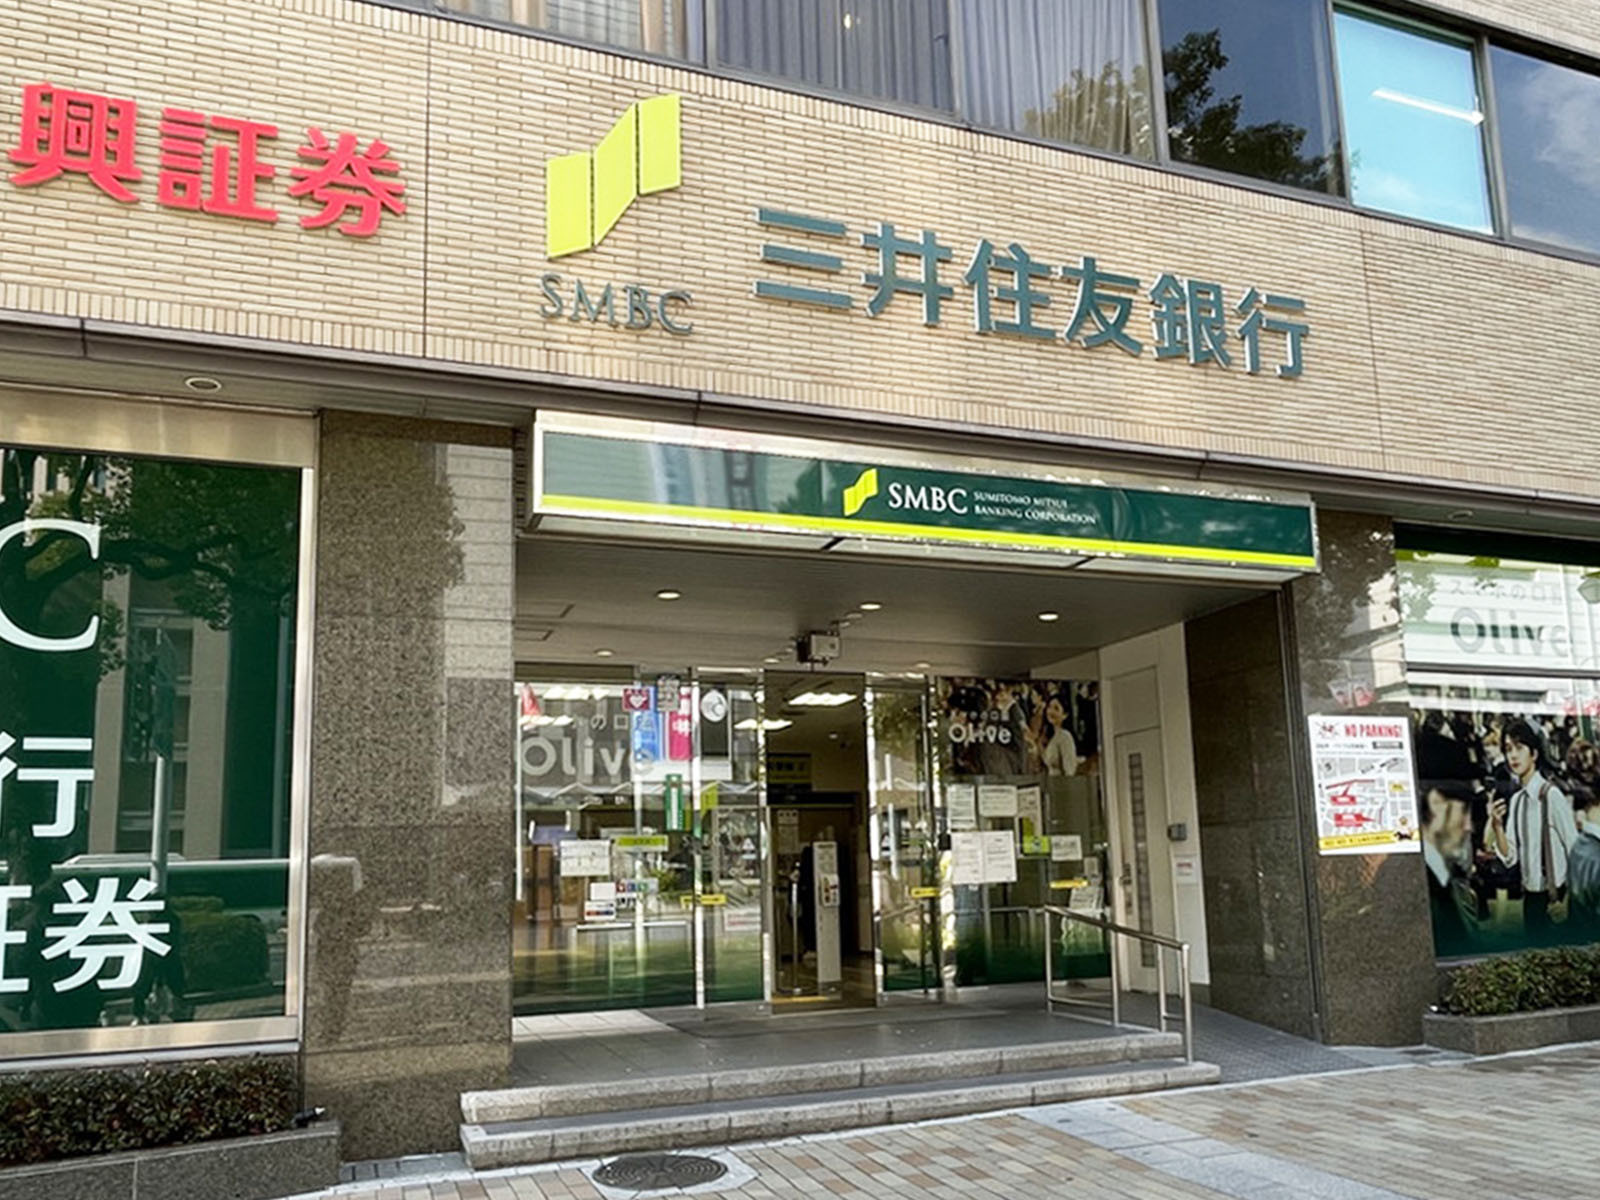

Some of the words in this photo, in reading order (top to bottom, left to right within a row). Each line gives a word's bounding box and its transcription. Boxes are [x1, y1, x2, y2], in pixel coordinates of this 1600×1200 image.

[8, 82, 406, 237] 興証券
[540, 273, 694, 336] SMBC
[753, 206, 1309, 378] 三井住友銀行
[888, 482, 968, 514] SMBC
[974, 490, 1030, 505] SUMITOMO
[975, 504, 1022, 518] BANKING
[1024, 508, 1096, 524] CORPORATION
[1450, 607, 1569, 658] Olive
[948, 722, 1012, 745] Olive
[1344, 723, 1358, 738] NO
[0, 877, 172, 993] 券
